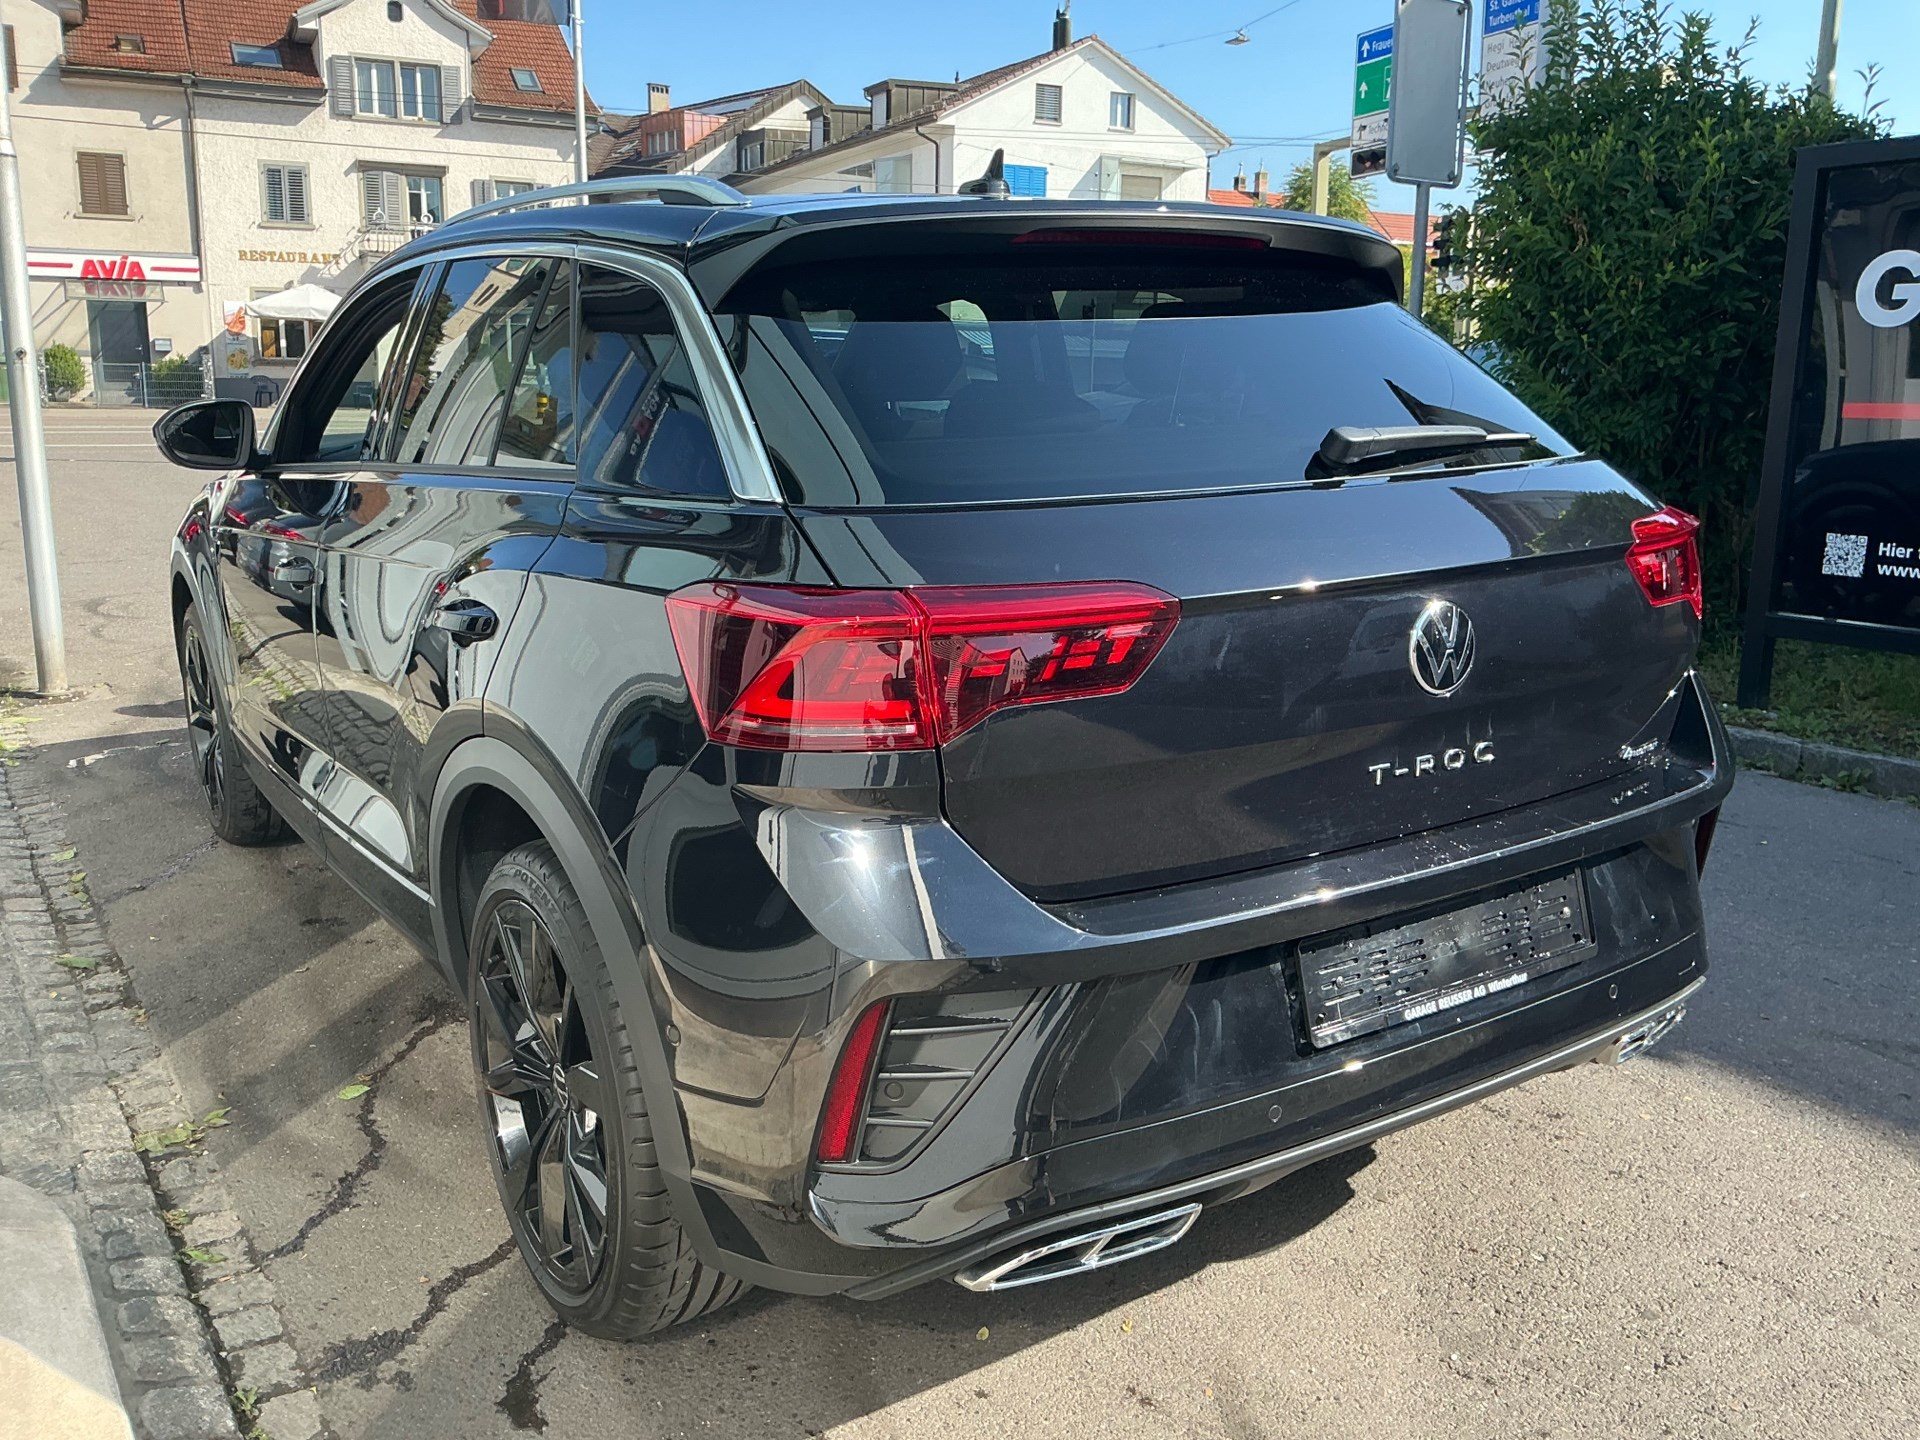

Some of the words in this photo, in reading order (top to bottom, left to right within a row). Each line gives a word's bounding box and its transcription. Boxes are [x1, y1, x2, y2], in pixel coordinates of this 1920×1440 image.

[238, 249, 341, 265] RESTAURANT
[1878, 541, 1914, 559] Hier
[1369, 741, 1495, 786] T-ROC
[1404, 1000, 1437, 1021] GARAGE
[1438, 988, 1474, 1010] REUSSER
[1473, 984, 1487, 998] AG
[1488, 971, 1528, 993] Winterthur
